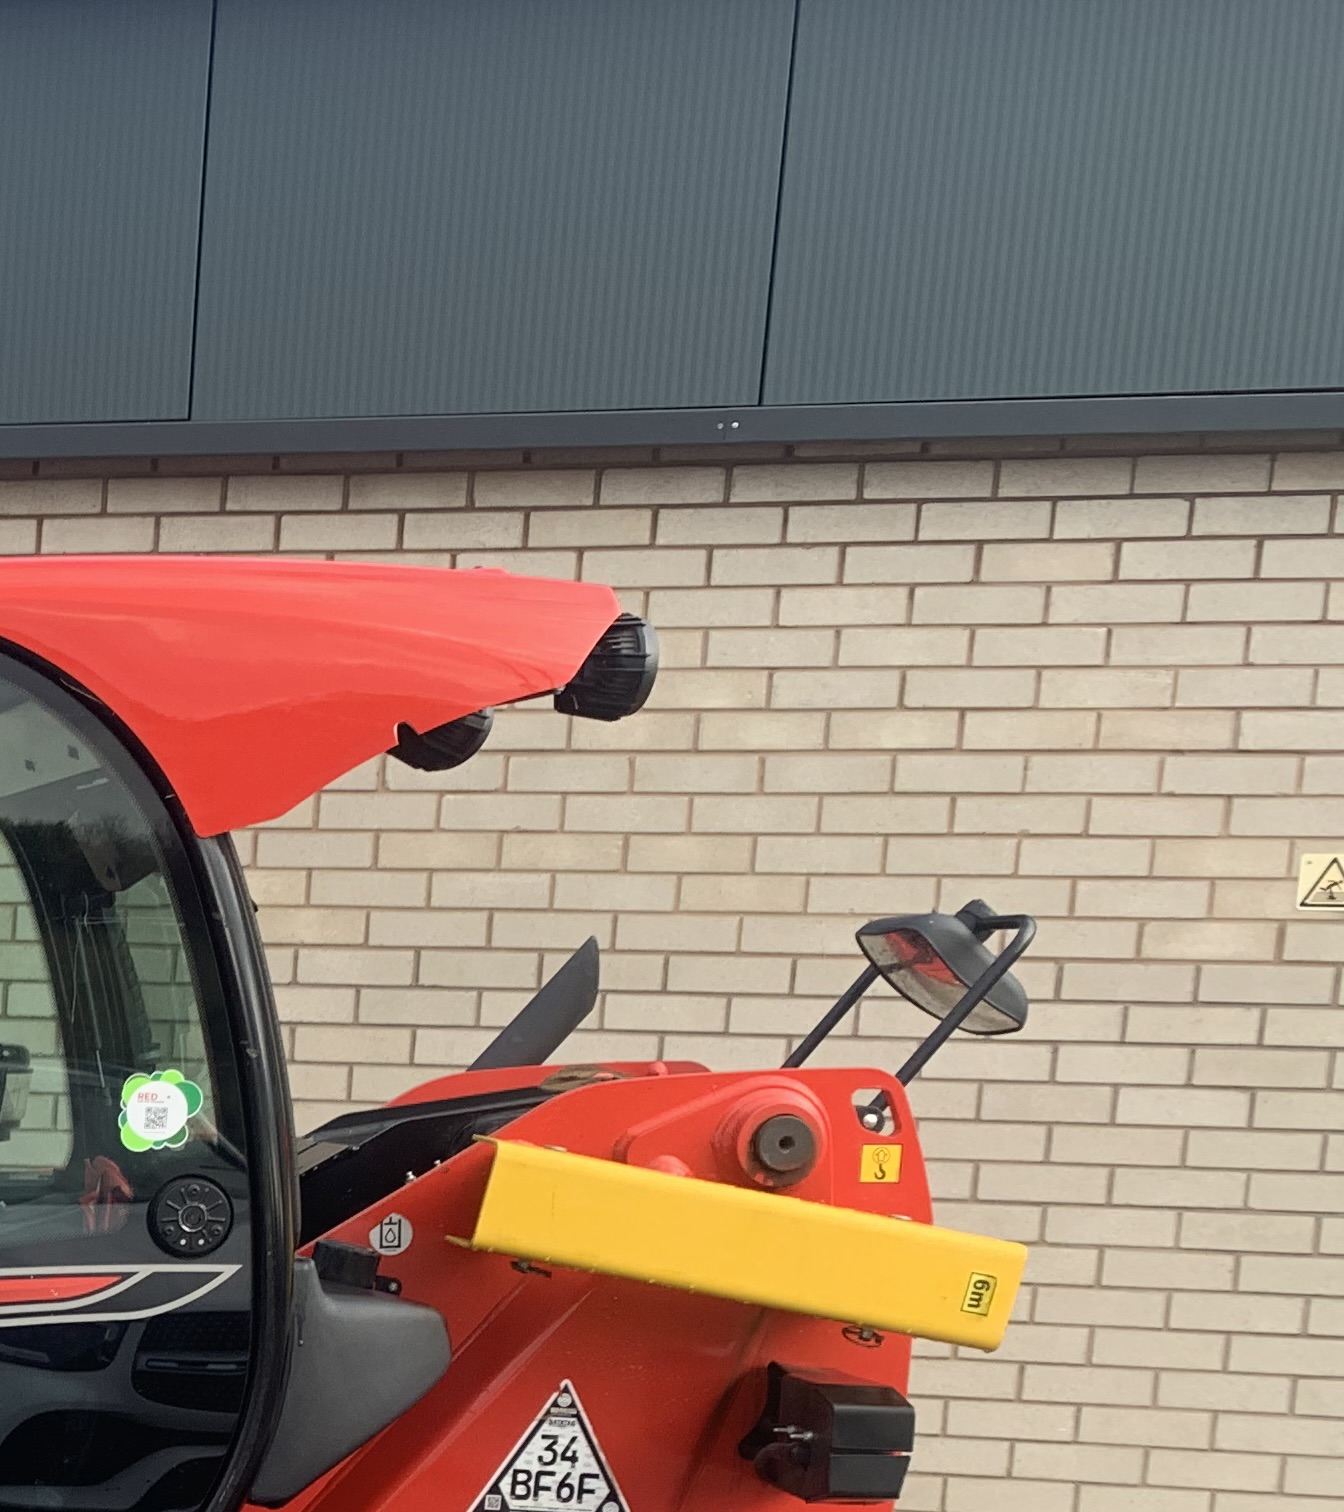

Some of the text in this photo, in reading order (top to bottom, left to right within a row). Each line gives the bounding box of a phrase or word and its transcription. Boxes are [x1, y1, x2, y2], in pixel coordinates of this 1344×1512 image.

[137, 1092, 159, 1101] RED
[967, 1279, 991, 1308] 6m
[537, 1433, 579, 1469] 34
[510, 1468, 600, 1505] BF6F
